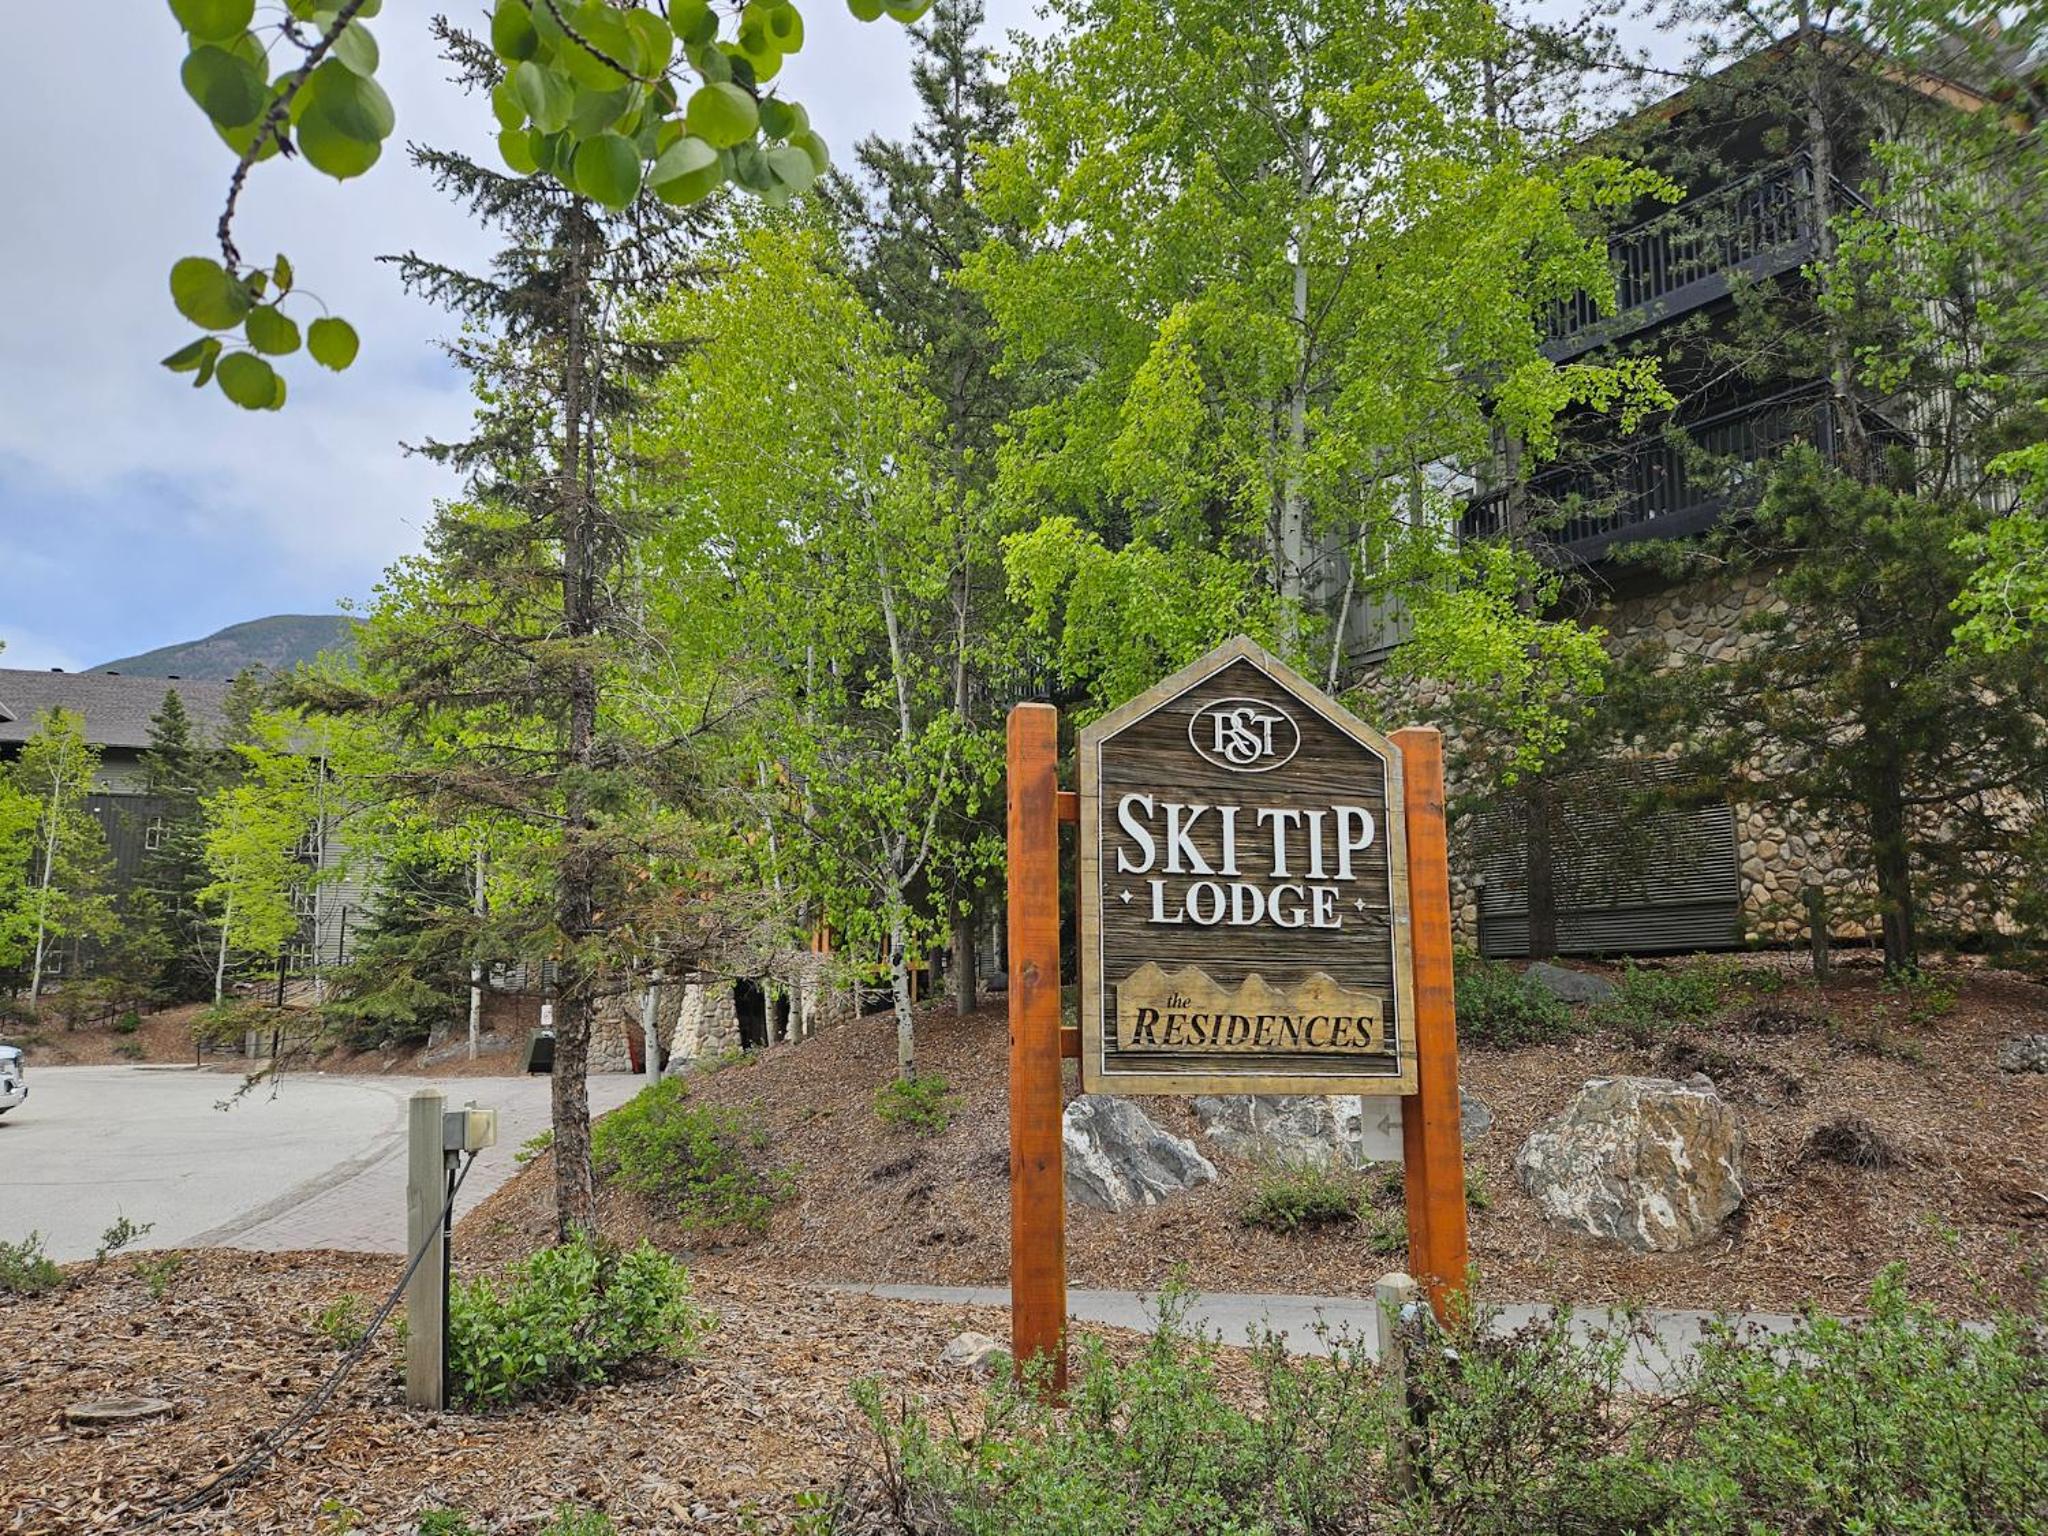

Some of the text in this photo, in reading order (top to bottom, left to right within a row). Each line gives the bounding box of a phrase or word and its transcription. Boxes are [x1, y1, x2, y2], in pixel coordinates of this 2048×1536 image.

[1117, 793, 1375, 880] SKI TIP
[1147, 880, 1342, 928] LODGE
[1167, 993, 1191, 1008] the
[1131, 1007, 1373, 1047] RESIDENCES
